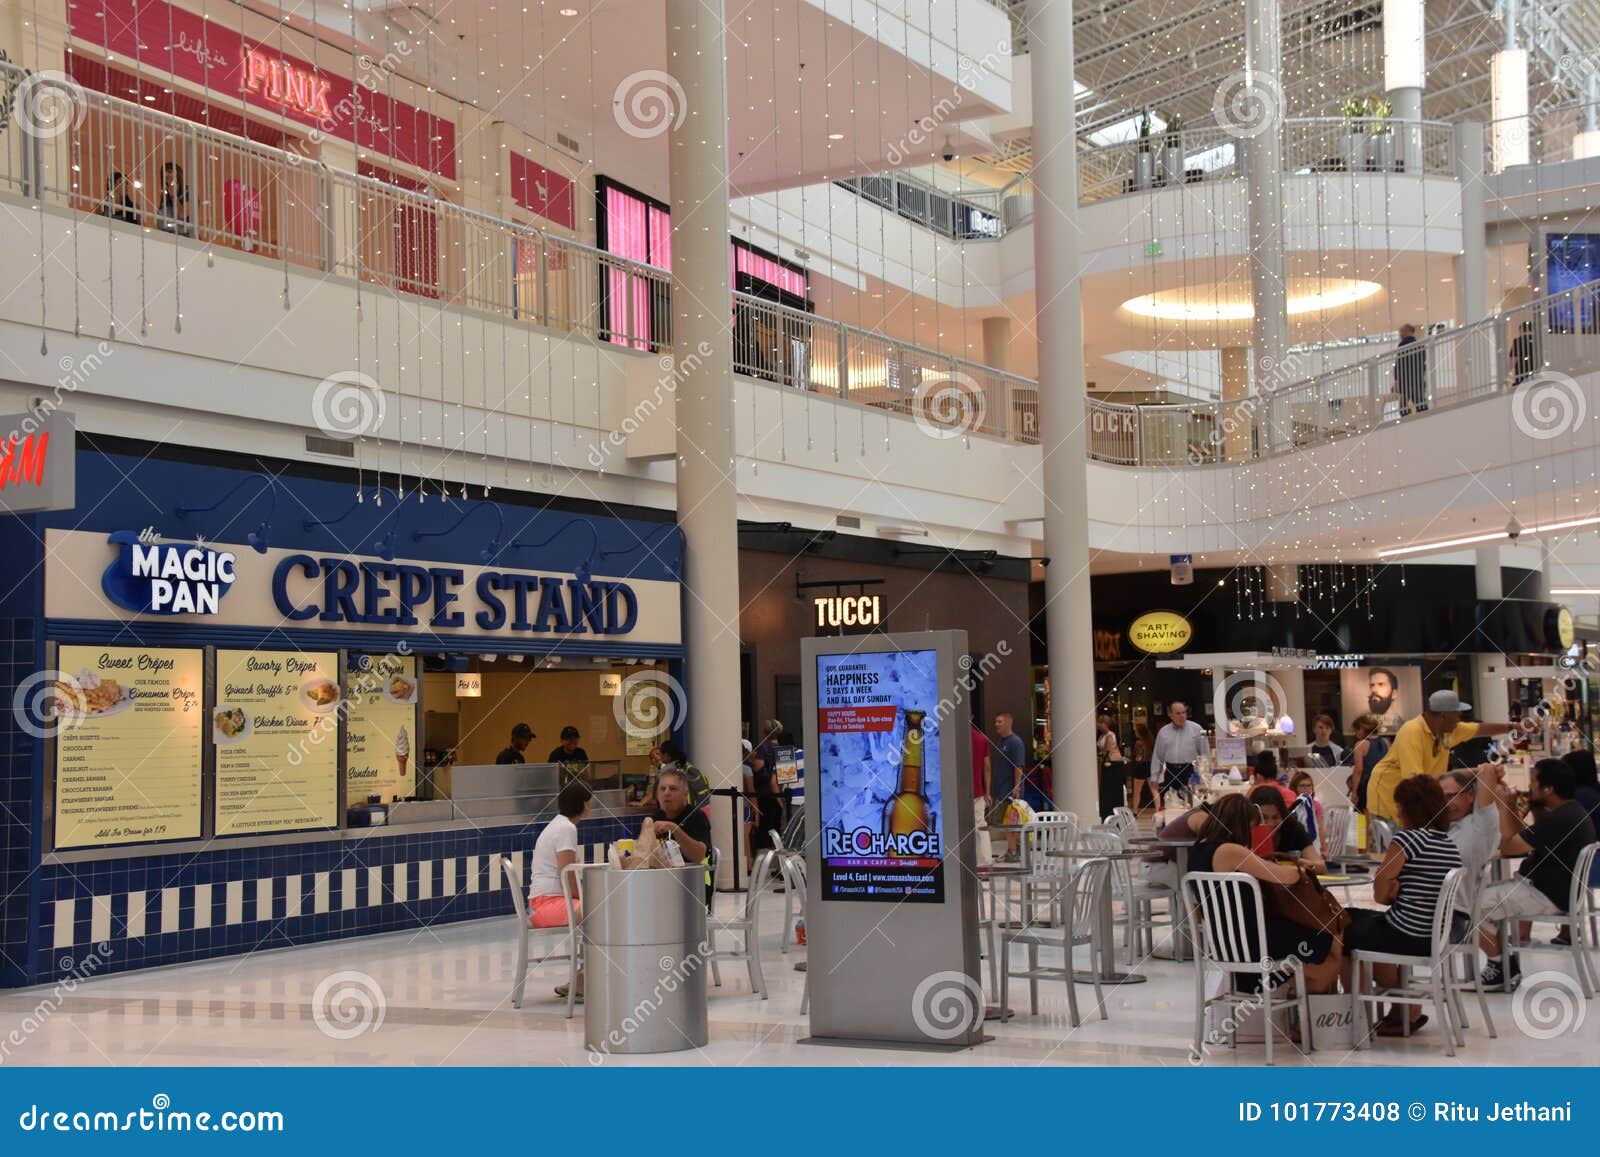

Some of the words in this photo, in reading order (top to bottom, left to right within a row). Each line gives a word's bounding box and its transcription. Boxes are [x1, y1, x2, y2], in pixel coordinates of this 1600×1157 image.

[243, 47, 331, 119] PINK
[137, 525, 162, 545] the
[132, 543, 236, 584] MAGIC
[151, 578, 219, 615] PAN
[475, 571, 638, 635] STAND
[814, 596, 880, 627] TUCCI
[1136, 630, 1186, 640] SHAVING
[1148, 623, 1168, 631] ART
[98, 653, 133, 670] Sweet
[247, 657, 282, 676] Savory
[826, 672, 879, 686] HAPPINESS
[128, 688, 169, 700] Cinnamon
[224, 684, 254, 697] Spinach
[826, 696, 839, 704] AND
[840, 696, 852, 704] ALL
[853, 695, 866, 703] DAY
[867, 695, 891, 703] SUNDAY
[253, 715, 284, 728] Chicken
[833, 872, 847, 881] Level
[855, 872, 868, 881] East
[1316, 1006, 1354, 1028] aeri
